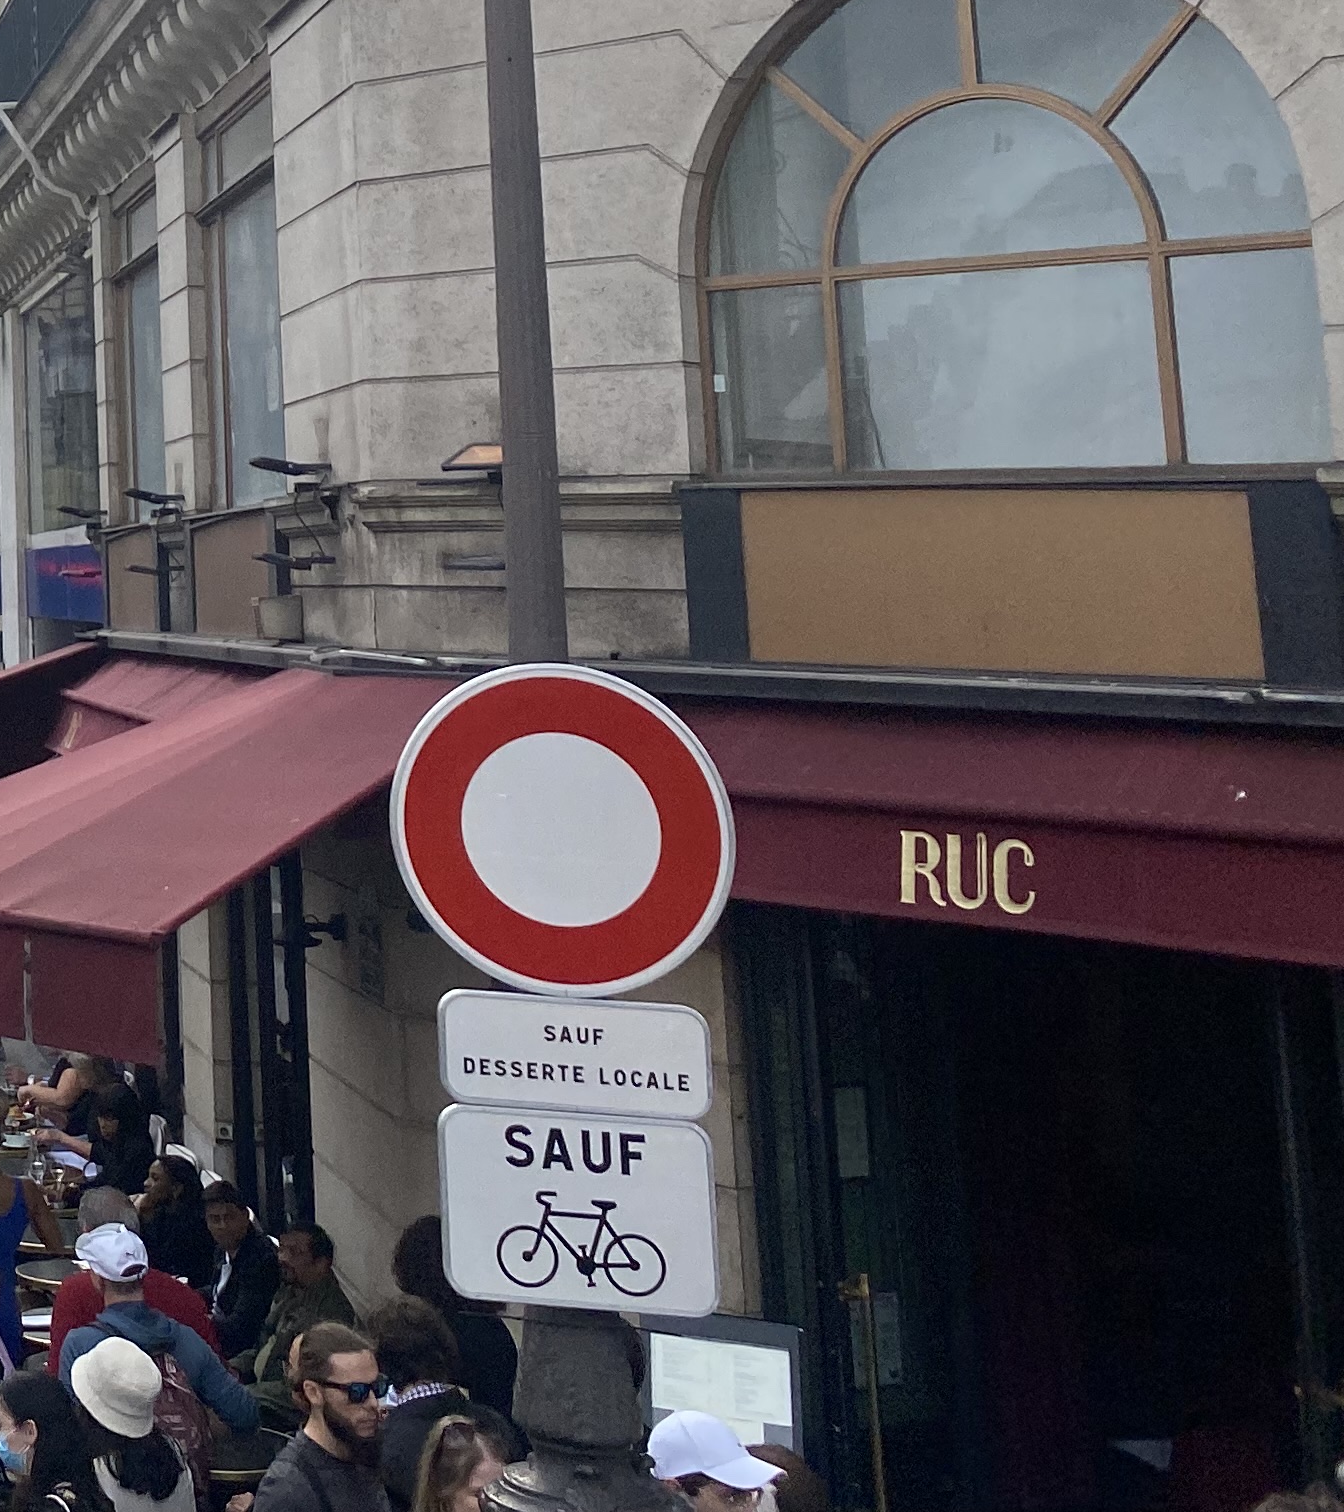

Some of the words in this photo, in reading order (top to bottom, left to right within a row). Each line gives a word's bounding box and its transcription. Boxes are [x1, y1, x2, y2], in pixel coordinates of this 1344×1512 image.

[899, 829, 1036, 915] RUC
[543, 1024, 605, 1046] SAUF
[463, 1056, 586, 1084] DESSERTE
[599, 1066, 691, 1093] LOCALE
[504, 1123, 647, 1177] SAUF
